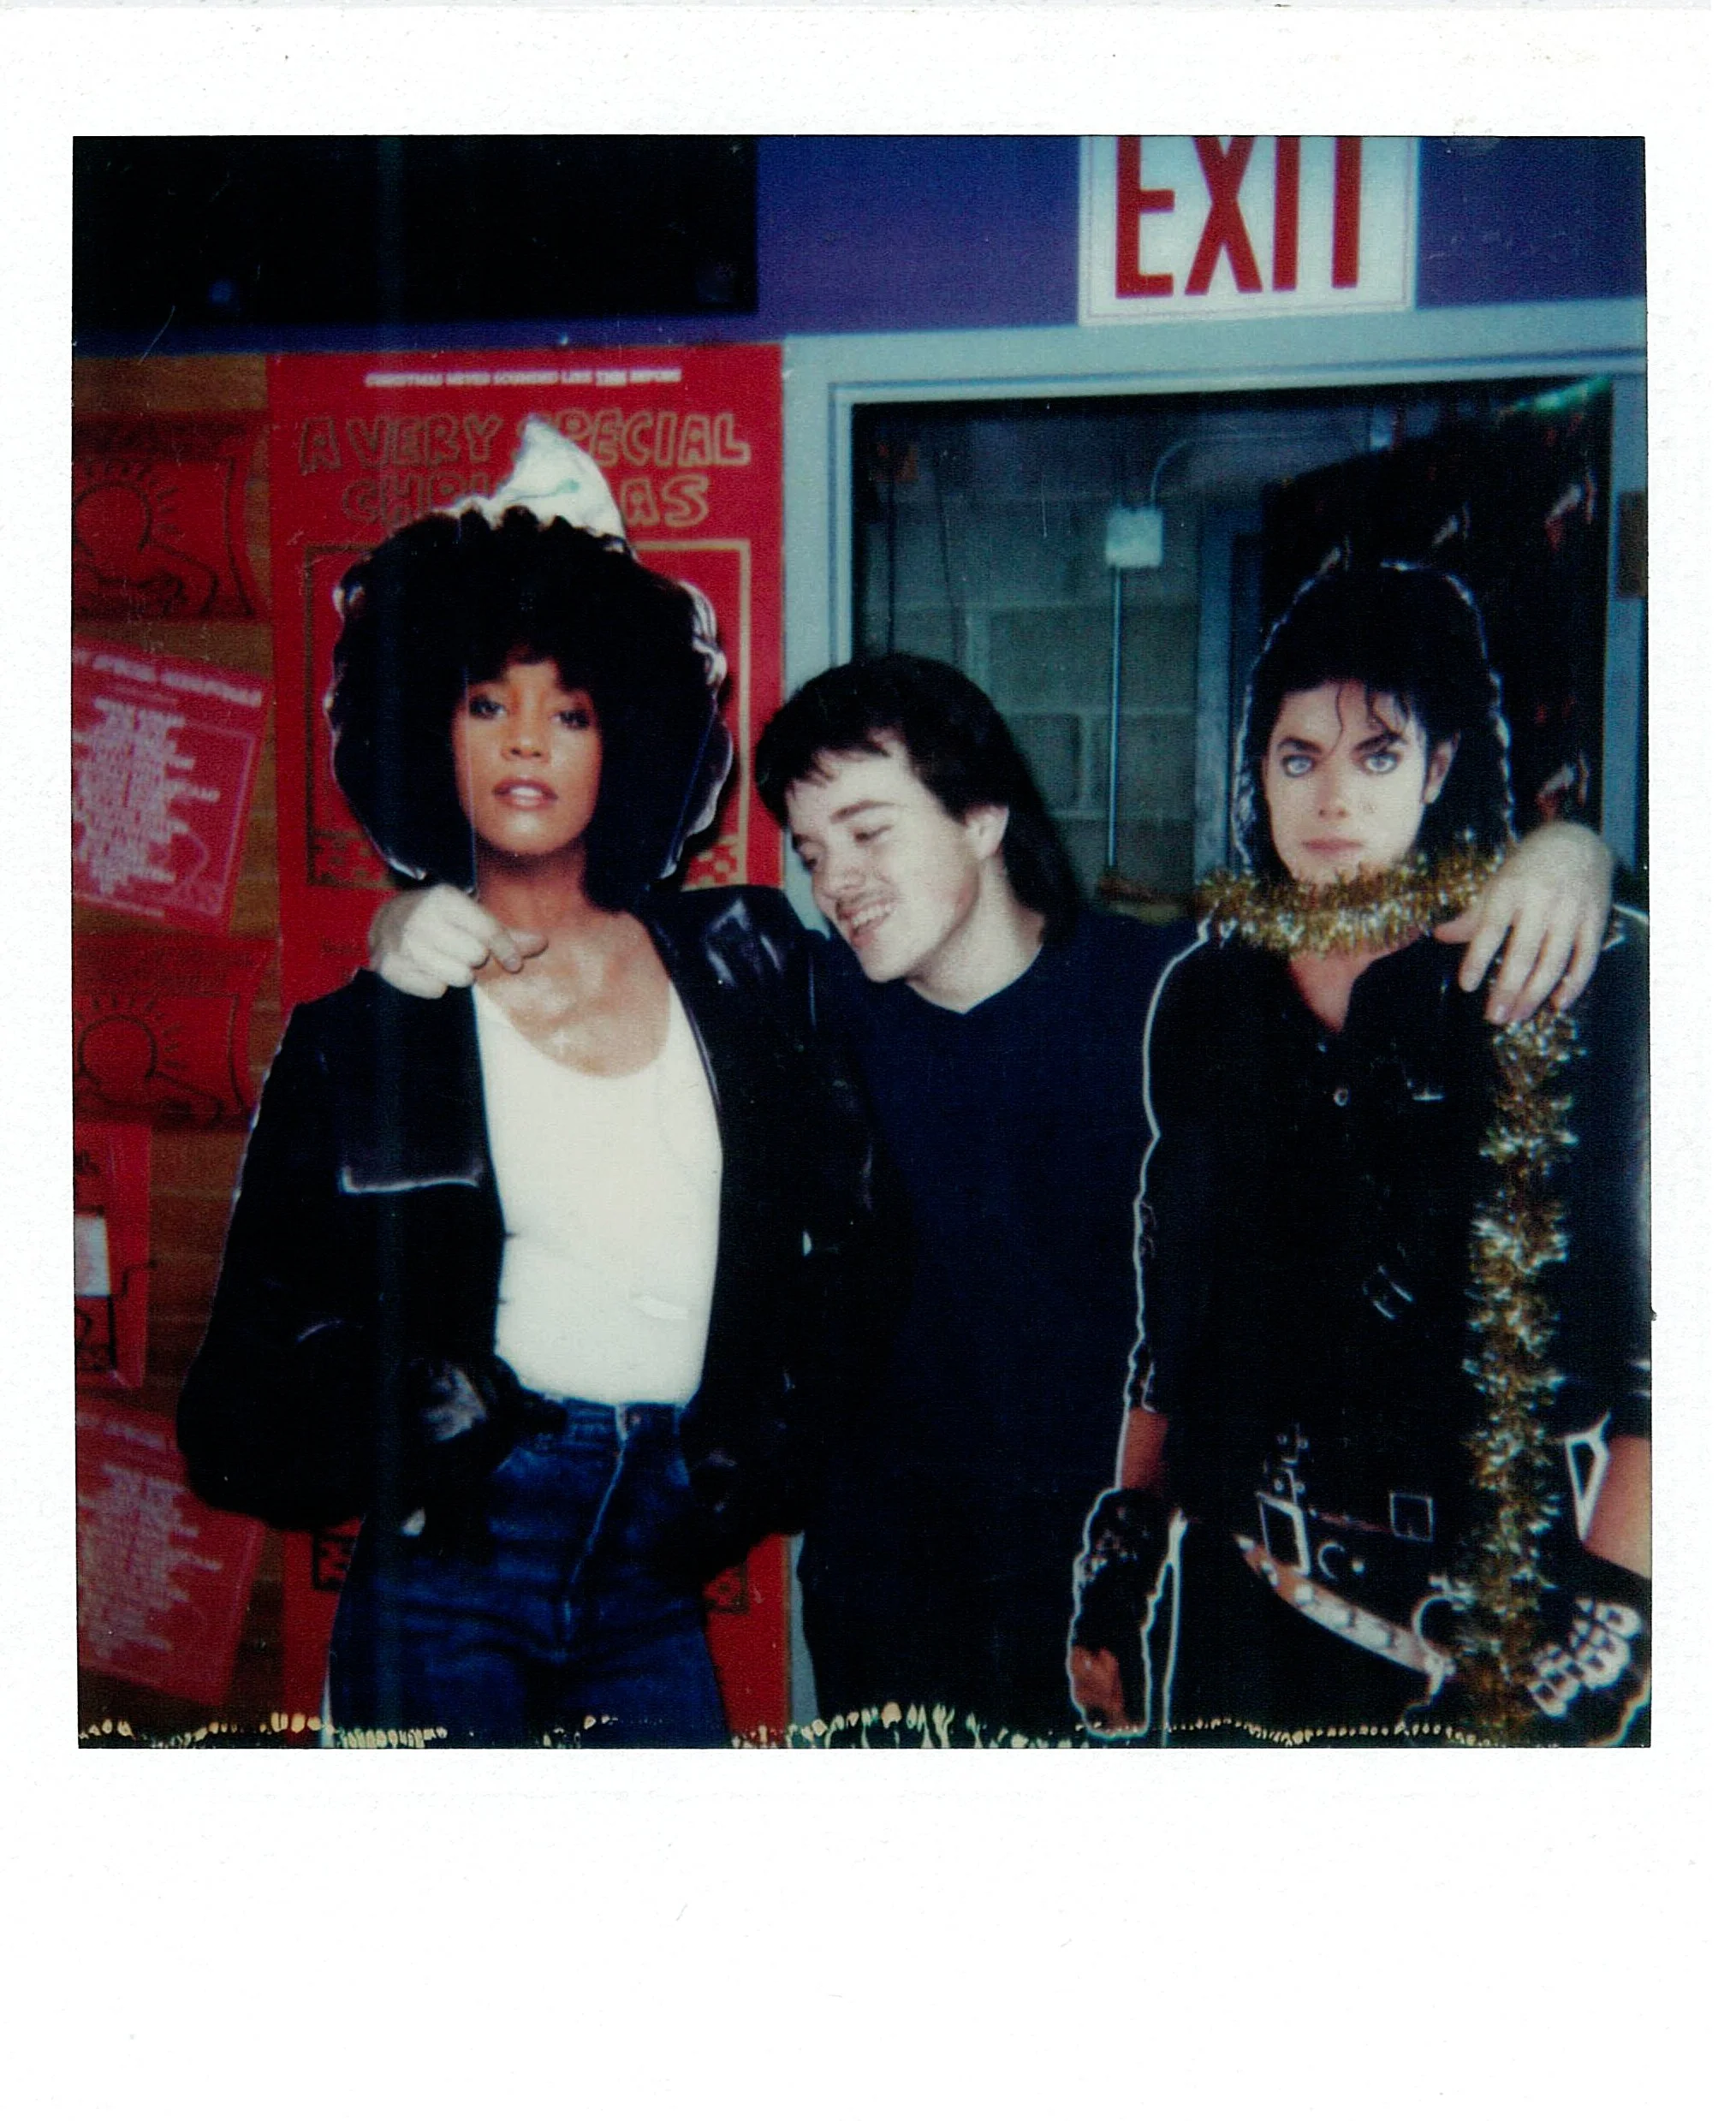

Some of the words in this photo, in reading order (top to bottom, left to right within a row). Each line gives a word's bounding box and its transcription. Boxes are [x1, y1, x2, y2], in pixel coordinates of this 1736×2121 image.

[1115, 136, 1363, 299] EXIT
[300, 416, 342, 476] A
[345, 413, 502, 466] VERY
[511, 407, 752, 467] PECIAL
